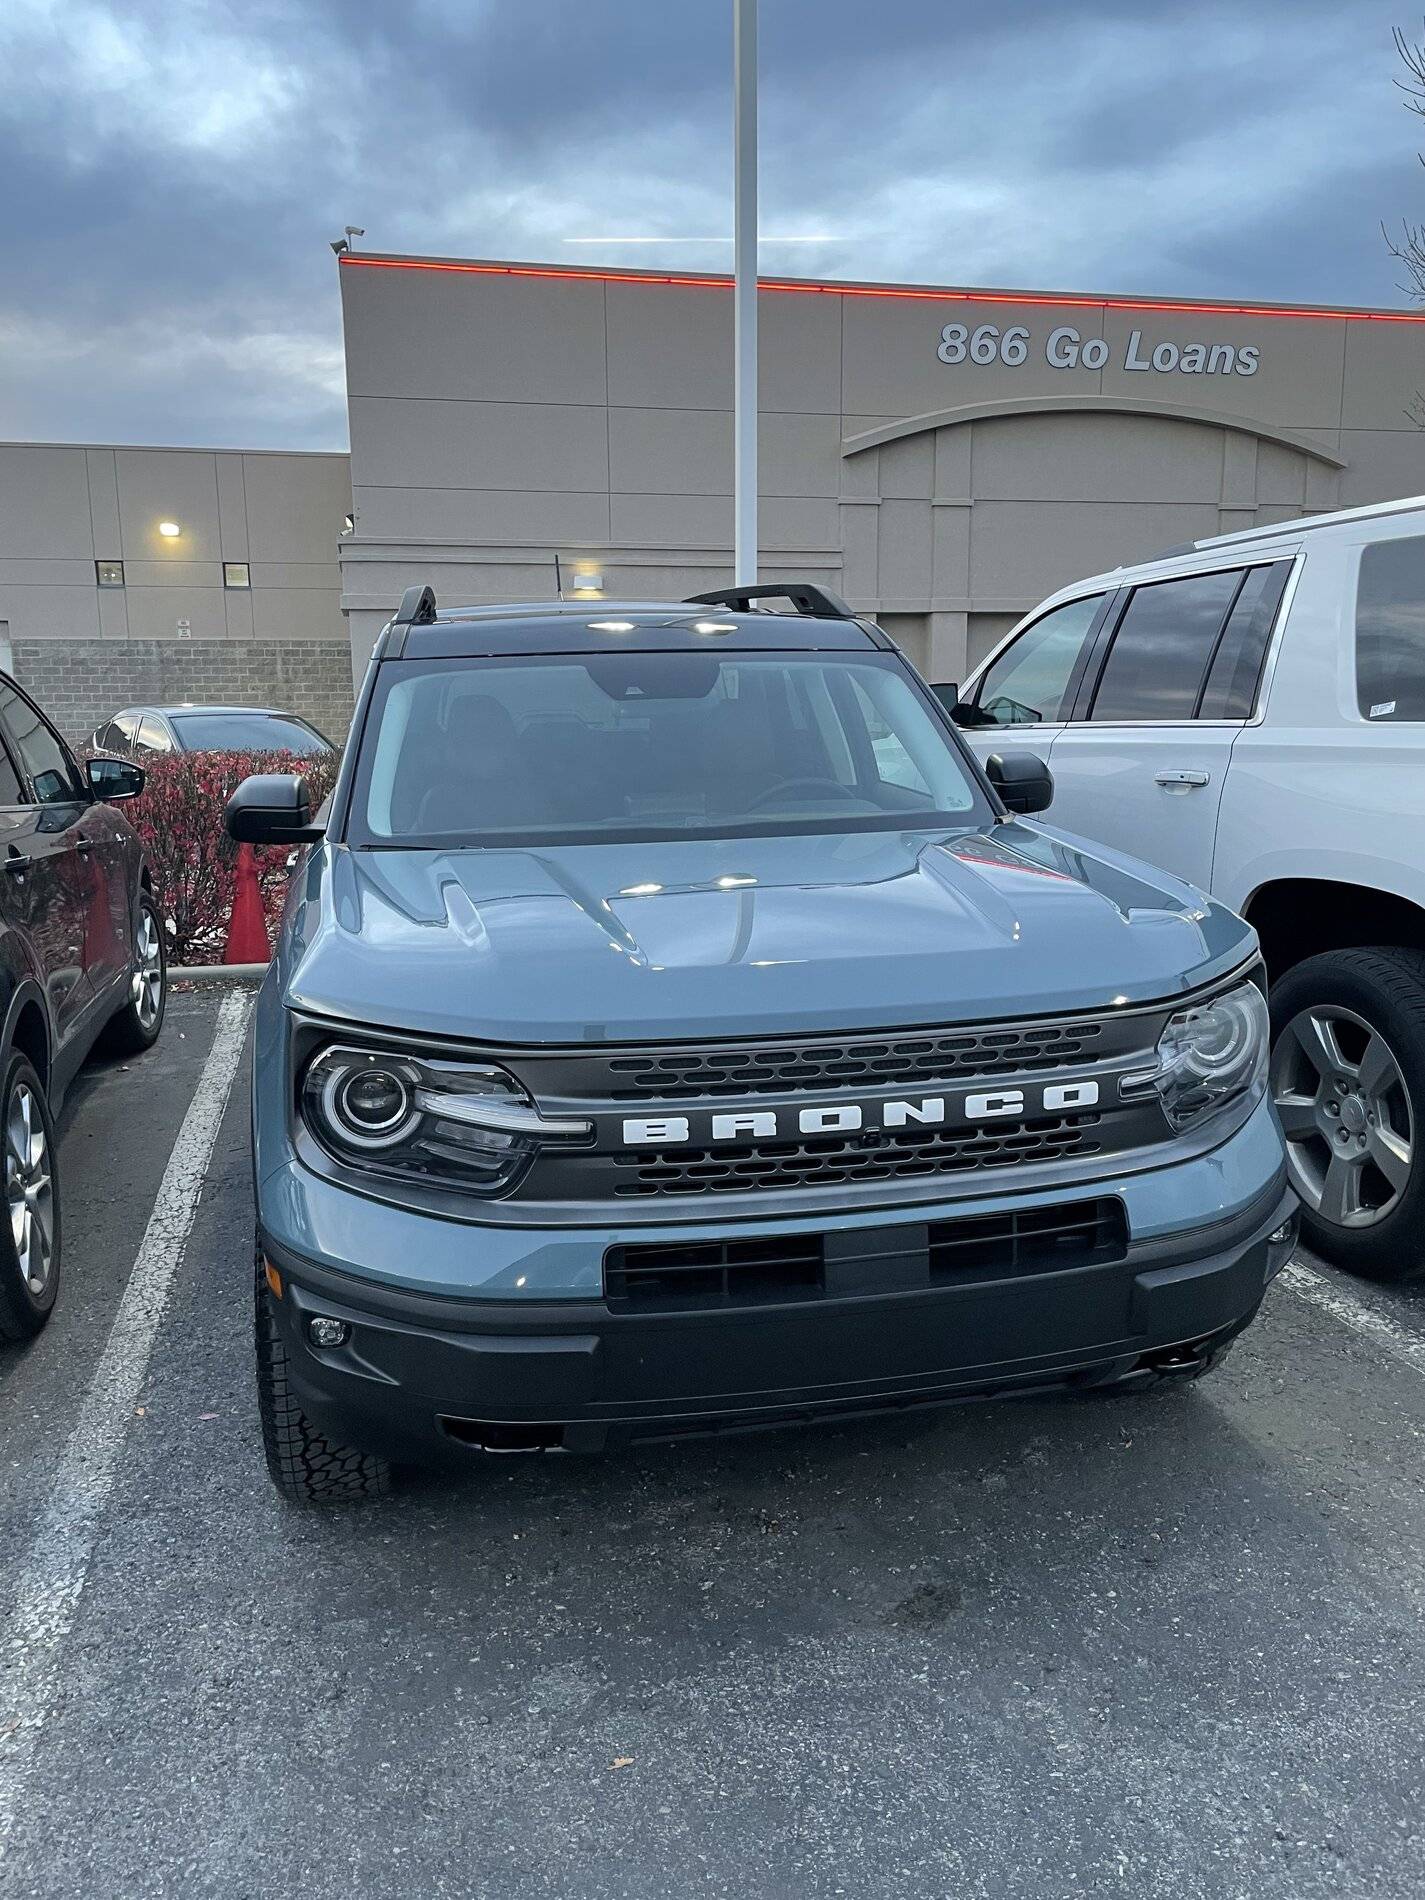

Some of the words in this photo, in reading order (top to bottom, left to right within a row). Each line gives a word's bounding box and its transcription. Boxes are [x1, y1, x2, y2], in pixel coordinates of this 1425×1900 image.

[937, 323, 1030, 367] 866
[1045, 326, 1110, 370] Go
[1123, 329, 1260, 376] Loans
[622, 1080, 1099, 1145] BRONCO
